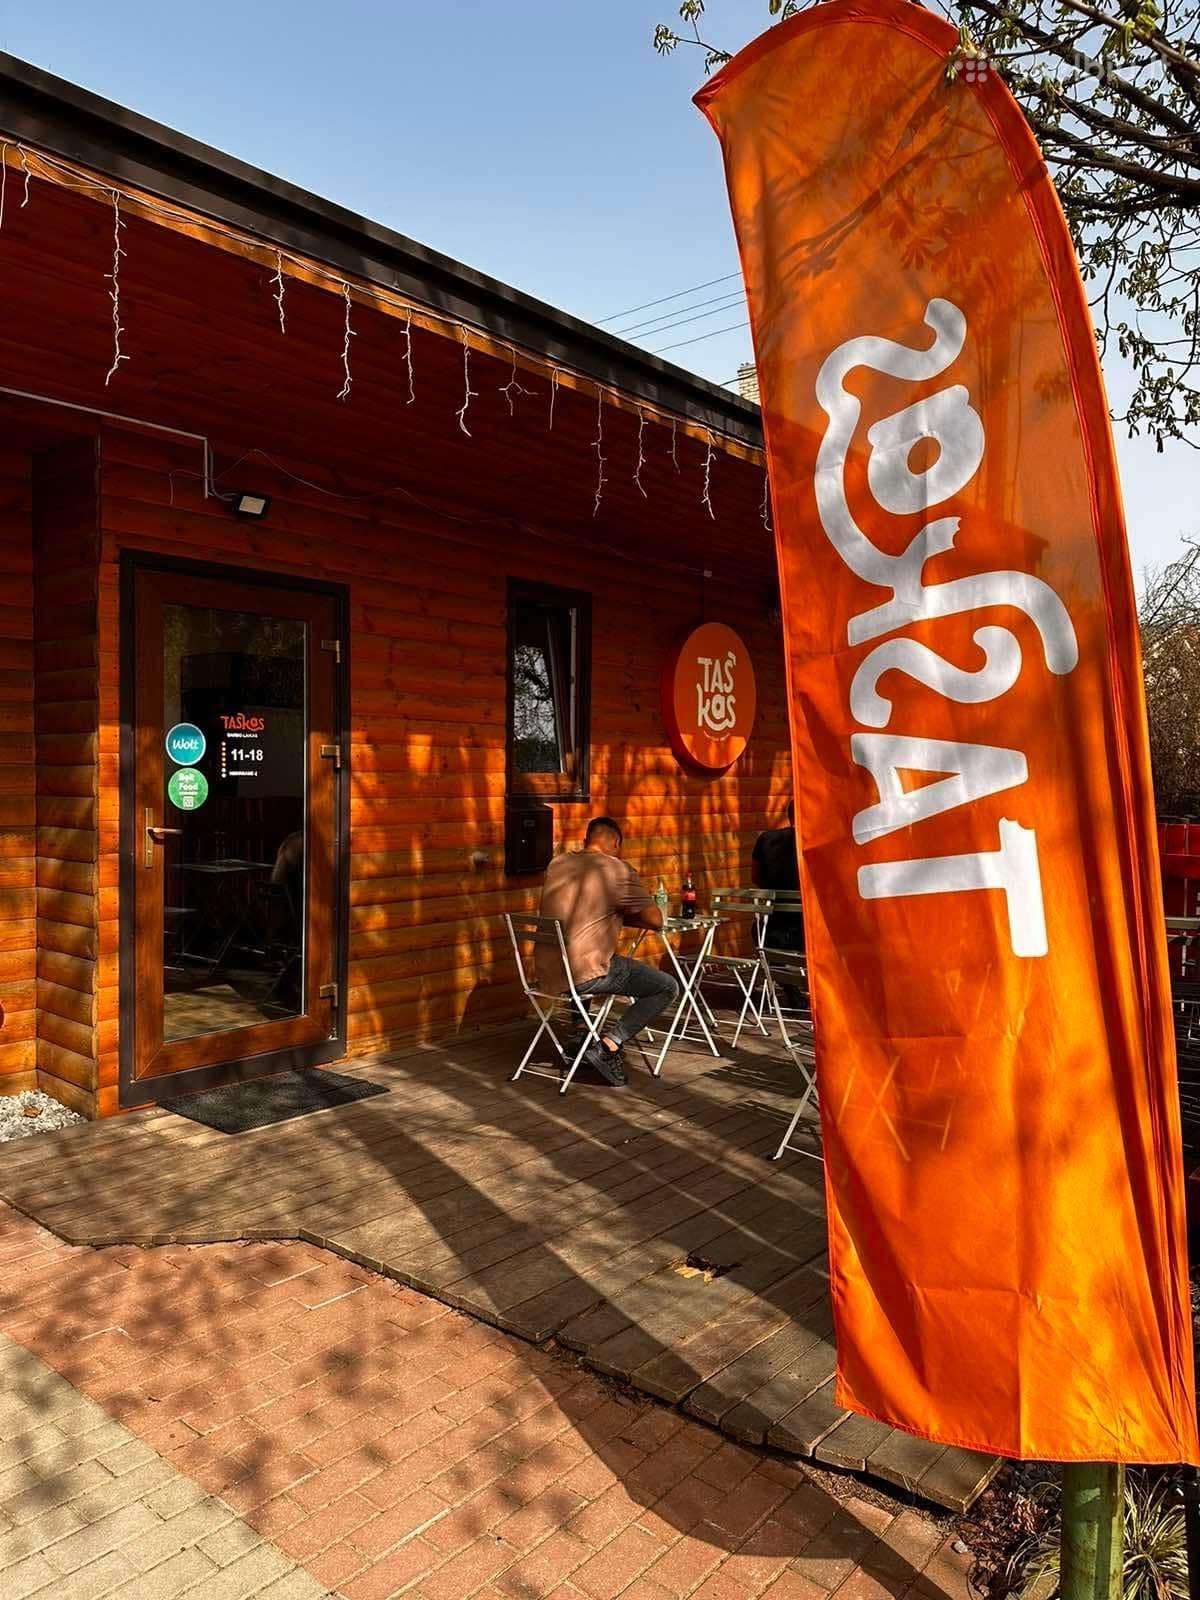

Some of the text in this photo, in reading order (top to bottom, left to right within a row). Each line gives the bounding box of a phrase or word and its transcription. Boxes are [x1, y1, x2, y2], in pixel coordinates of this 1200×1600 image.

[172, 738, 200, 750] Wolt
[230, 749, 264, 761] 11-18
[179, 782, 199, 791] Food
